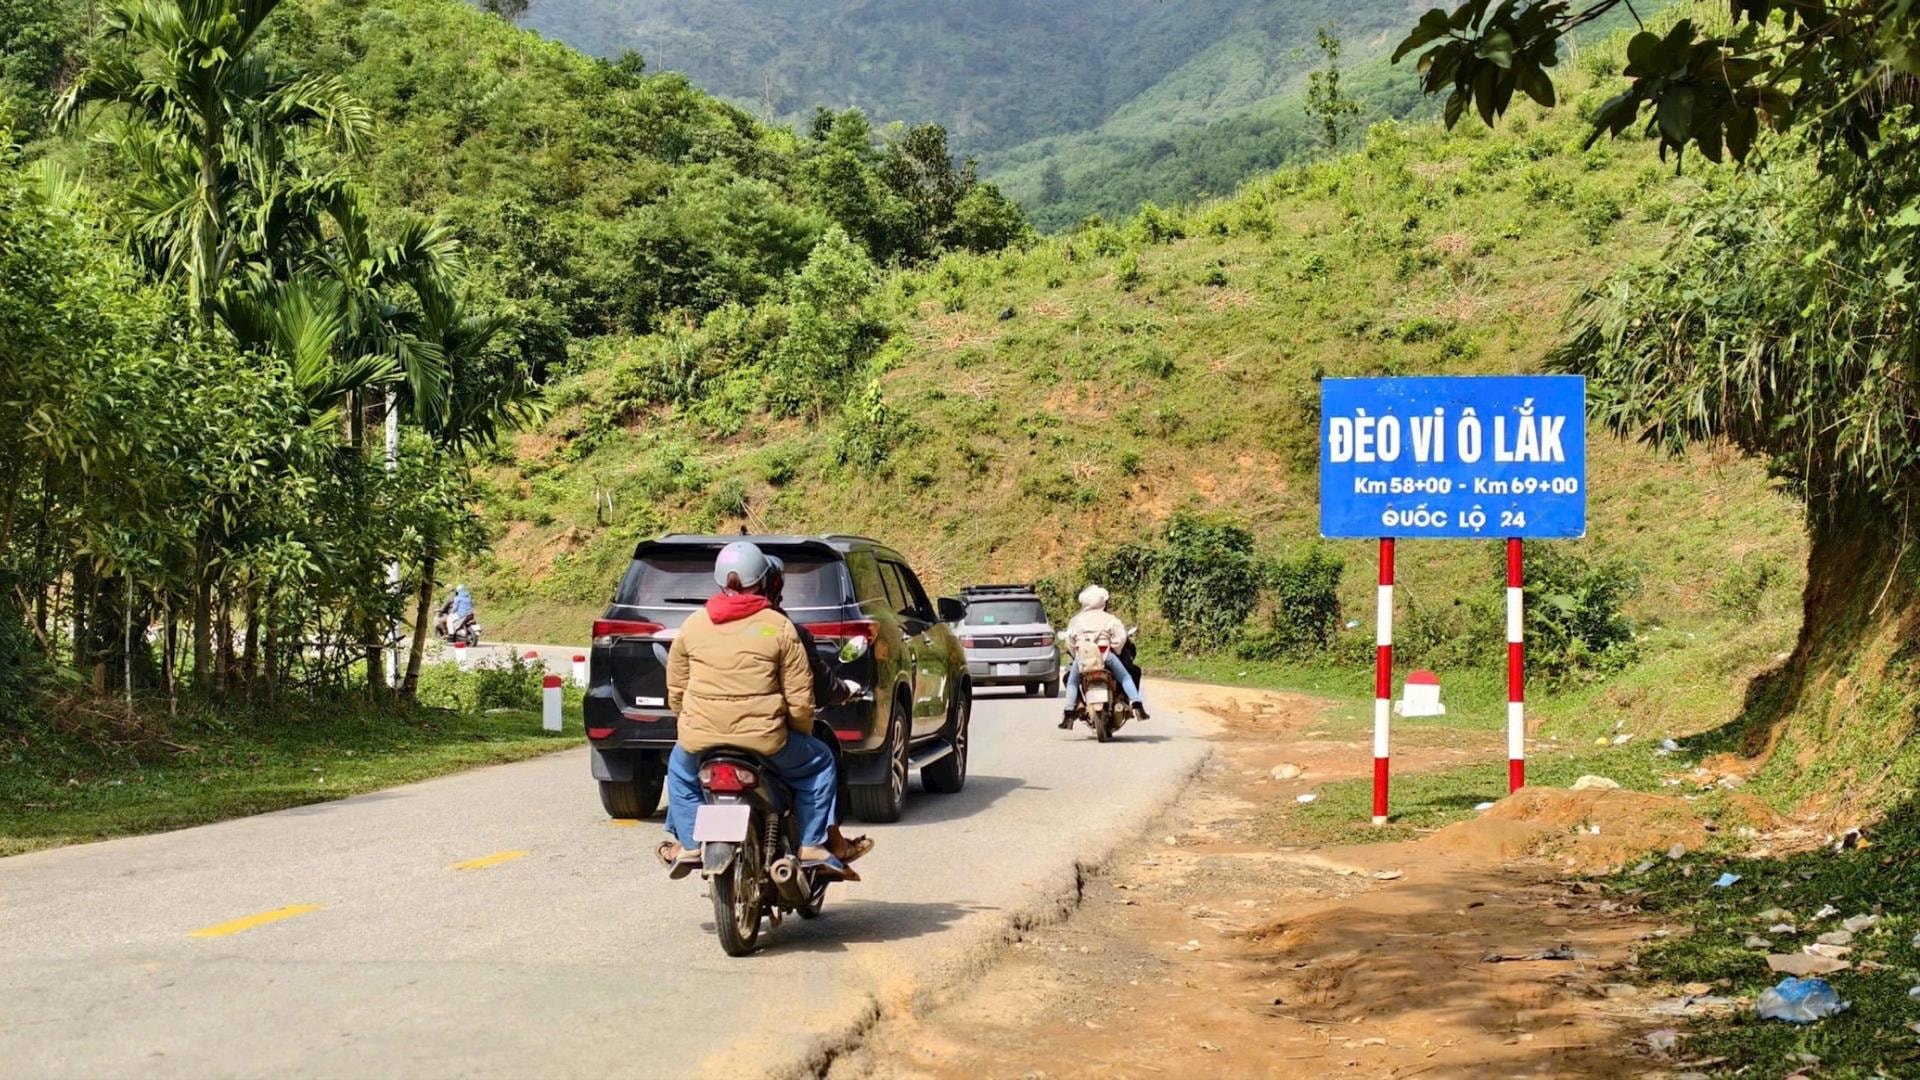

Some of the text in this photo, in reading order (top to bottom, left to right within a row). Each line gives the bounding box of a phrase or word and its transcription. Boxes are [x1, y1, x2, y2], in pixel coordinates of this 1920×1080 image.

[1329, 407, 1401, 463] ĐÈO
[1457, 407, 1482, 464] Ô
[1494, 397, 1566, 463] LẮK
[1381, 502, 1526, 532] QUỐC LỘ 24
